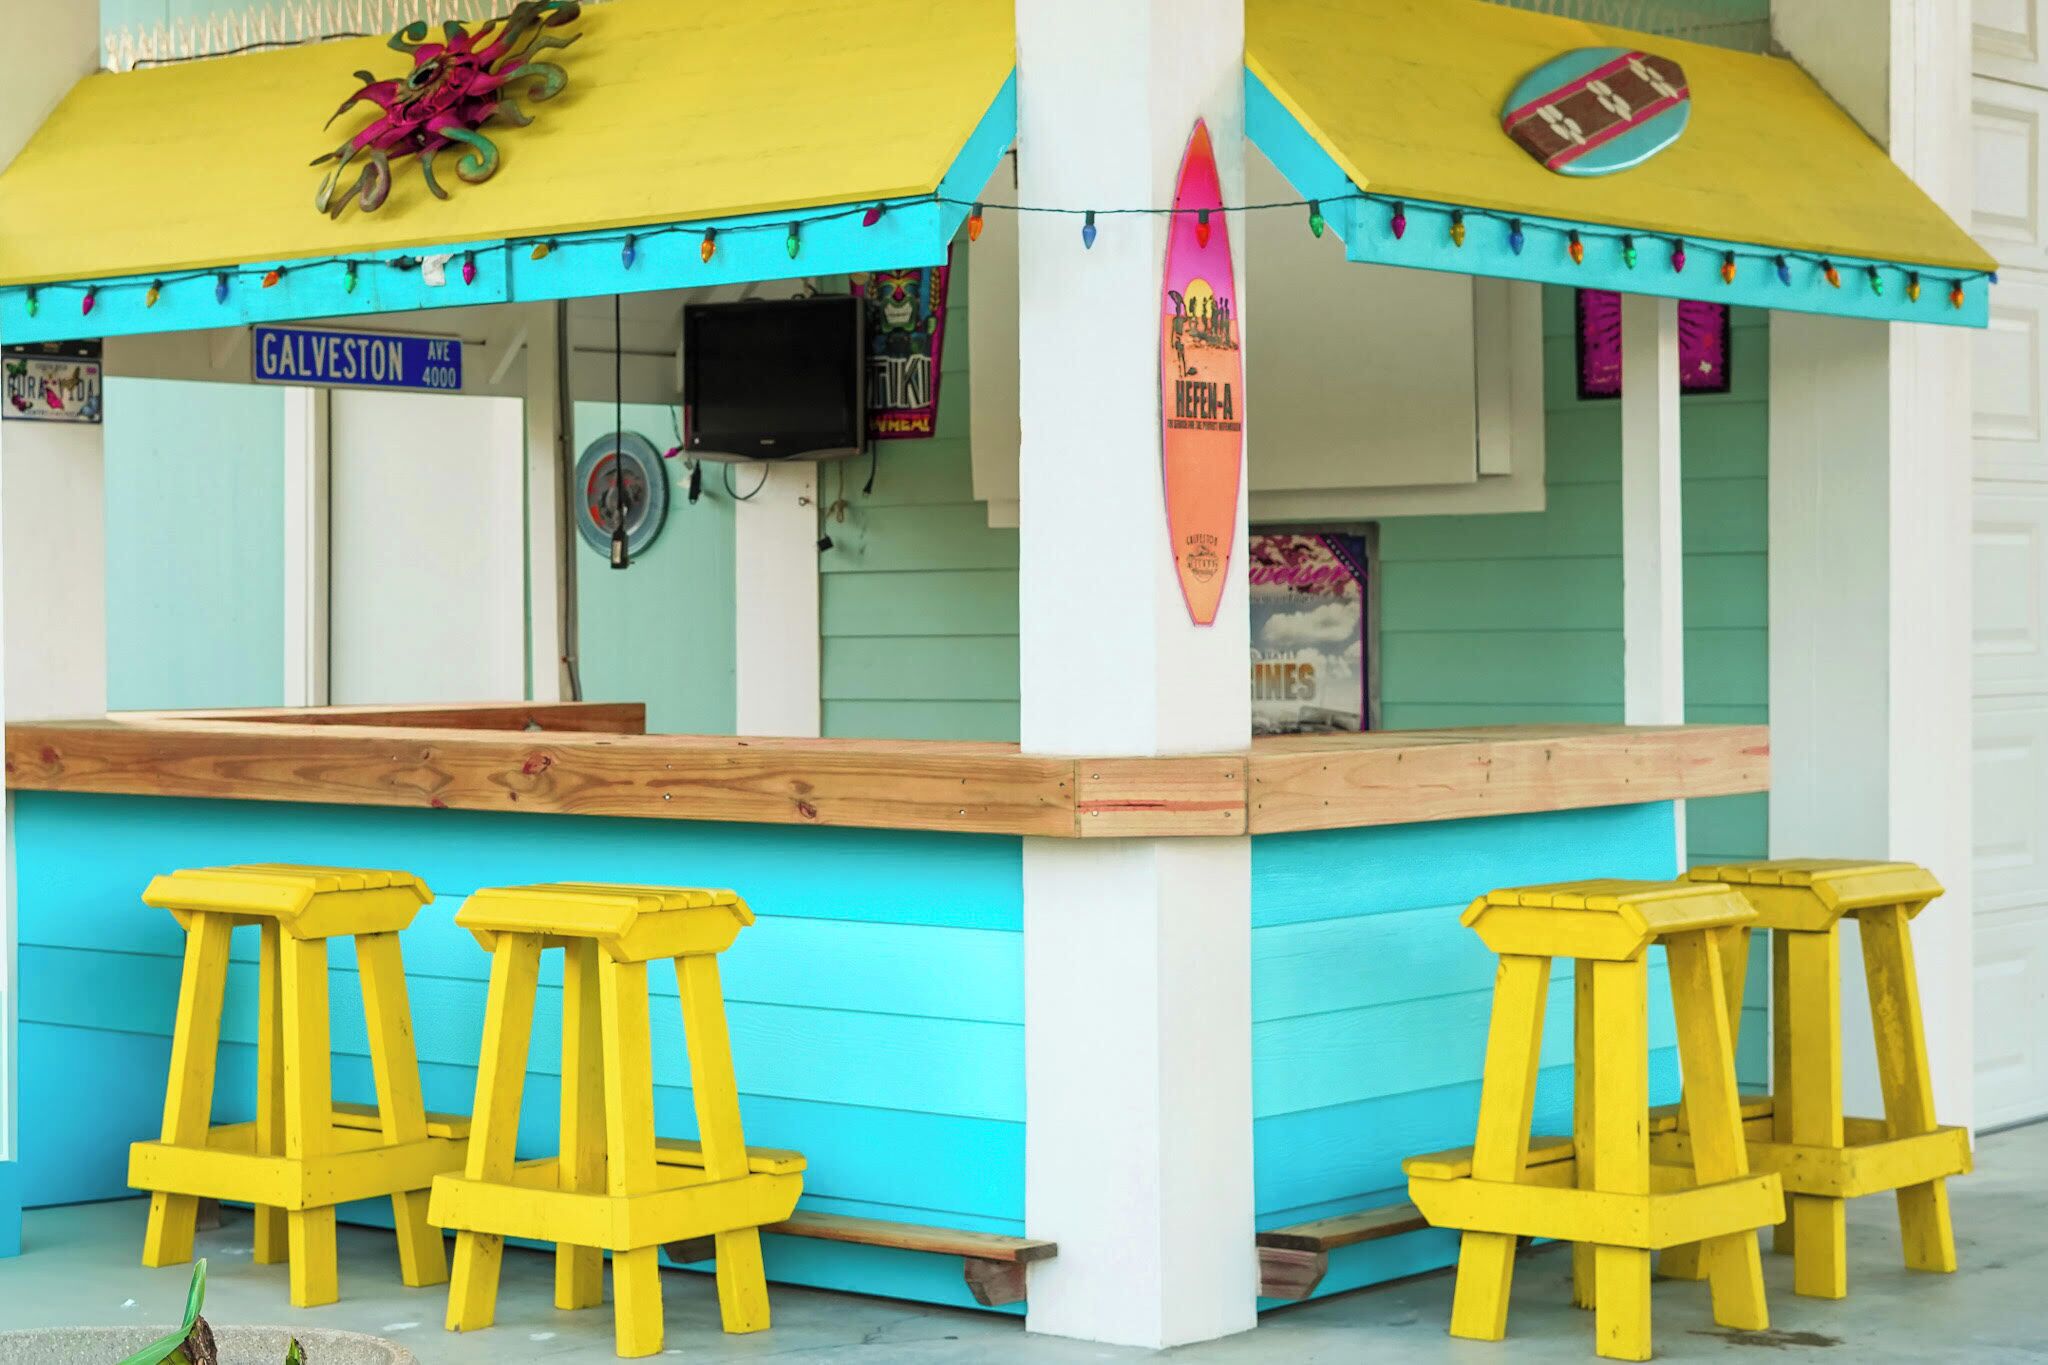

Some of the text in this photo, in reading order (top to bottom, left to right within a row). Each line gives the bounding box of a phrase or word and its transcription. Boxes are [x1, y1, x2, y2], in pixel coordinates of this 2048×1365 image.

[262, 333, 403, 381] GALVESTON
[428, 341, 450, 361] AVE
[422, 367, 456, 387] 4000
[868, 353, 931, 408] TIKI
[1176, 380, 1233, 420] HEFEN-A
[1249, 662, 1316, 701] INES
